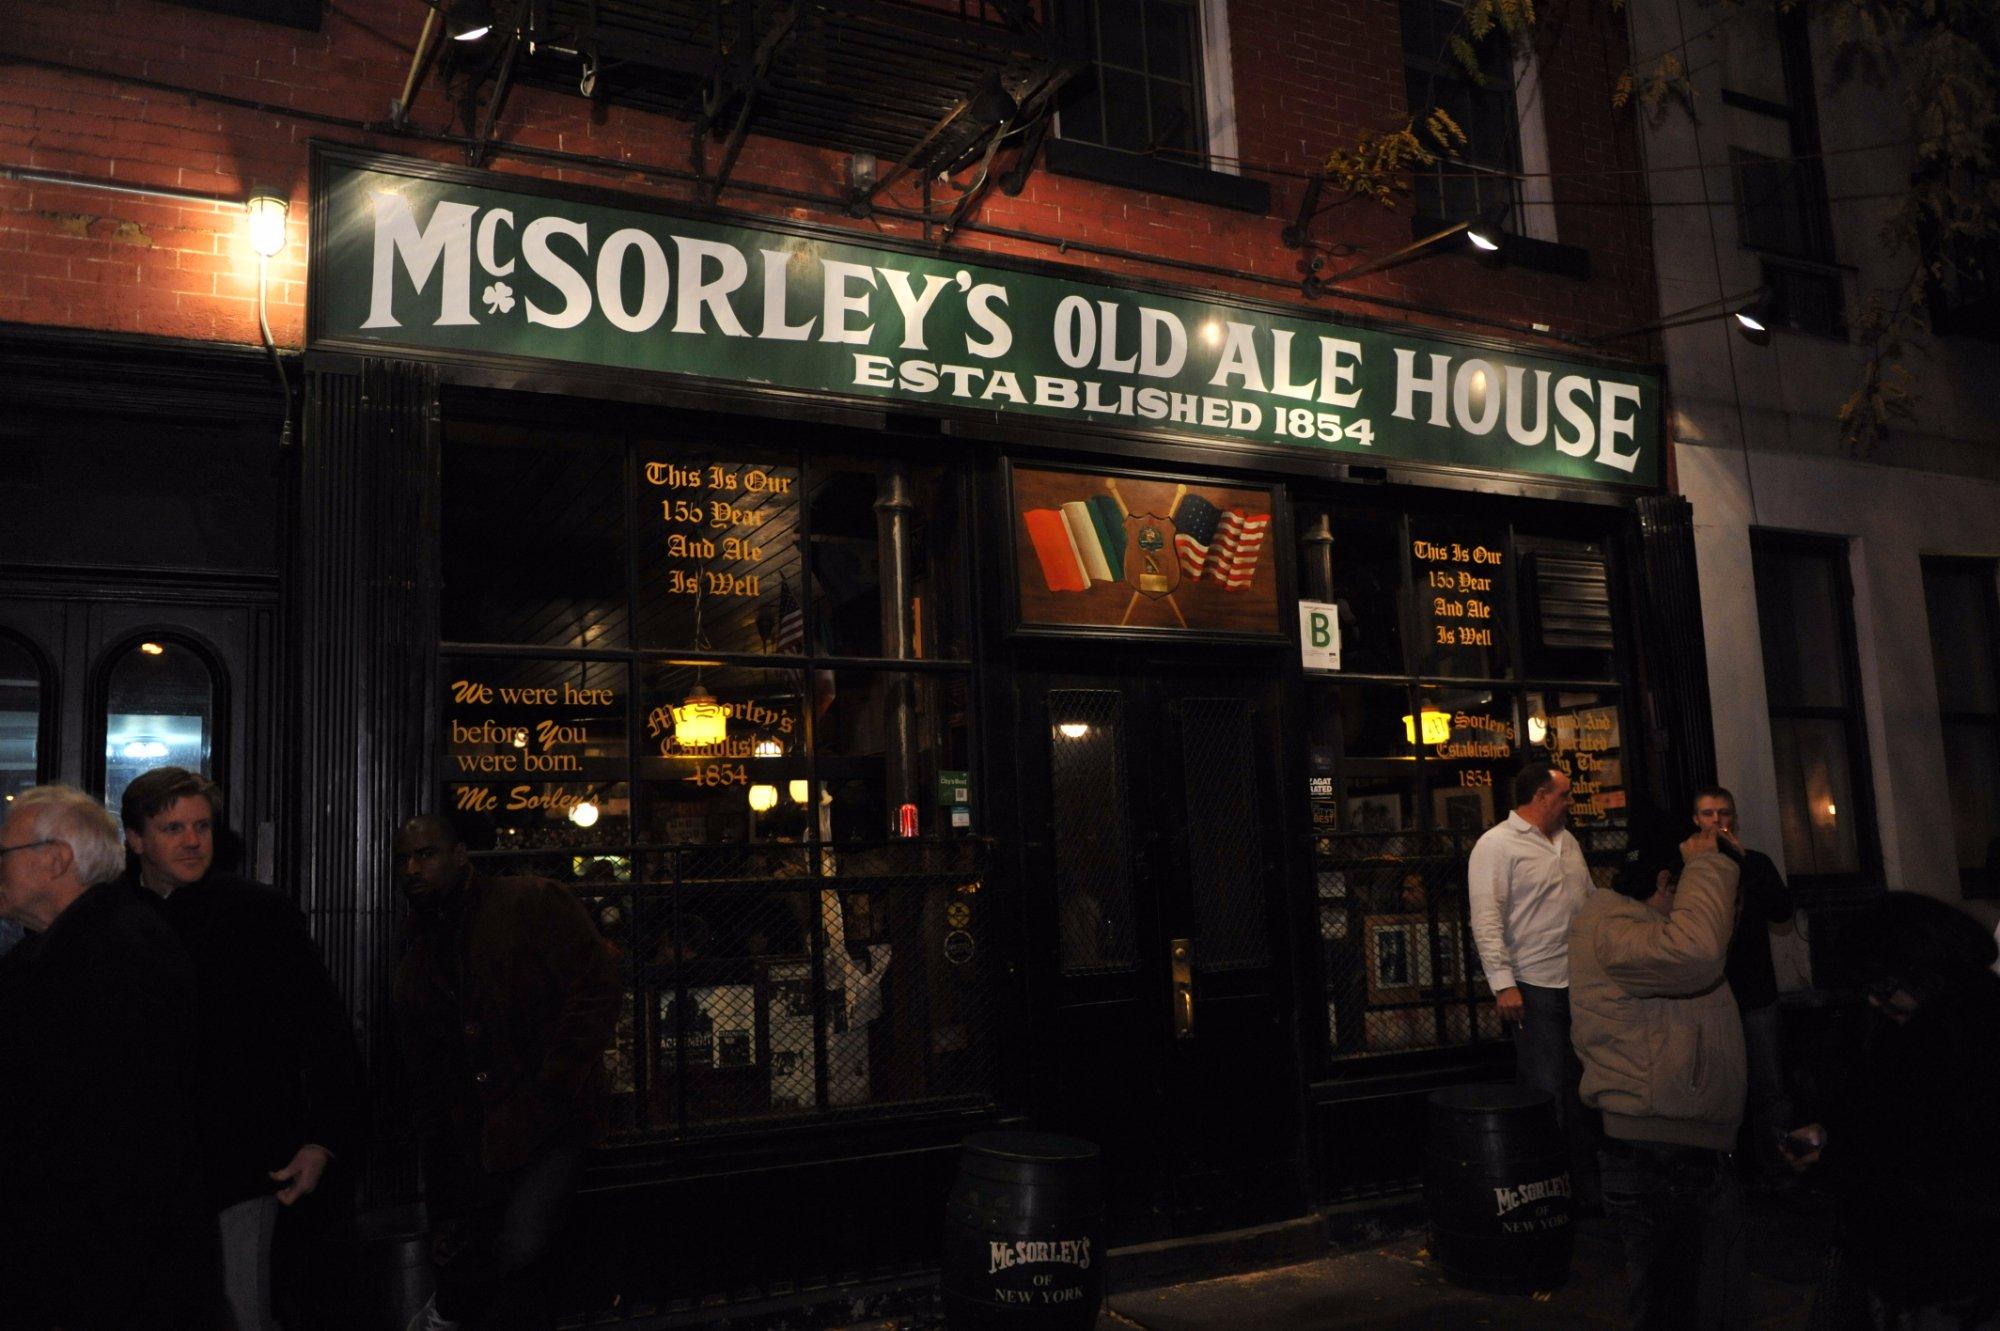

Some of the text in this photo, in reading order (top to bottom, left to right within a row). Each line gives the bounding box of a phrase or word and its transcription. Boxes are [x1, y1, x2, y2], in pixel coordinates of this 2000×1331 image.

[359, 190, 1641, 473] McSORLEY'S OLD ALE HOUSE
[852, 353, 1374, 446] ESTABLISHED 1854
[645, 461, 791, 494] This Is Our
[710, 501, 763, 528] Year
[667, 534, 762, 561] And Ale
[1413, 540, 1502, 565] This Is Our
[667, 569, 761, 597] Is Well
[1457, 571, 1492, 593] Year
[1434, 597, 1491, 618] And Ale
[1311, 613, 1330, 647] B
[1436, 626, 1493, 646] Is Well
[451, 680, 613, 706] We were here
[452, 719, 587, 751] before You
[457, 748, 583, 773] were born.
[694, 763, 748, 787] 1854
[1458, 769, 1493, 788] 1854
[457, 783, 600, 812] Mc Sorley's
[1502, 1219, 1537, 1233] NEW
[988, 1235, 1092, 1274] McSORLEY'S
[1033, 1274, 1053, 1287] OF
[995, 1285, 1085, 1304] NEW YORK
